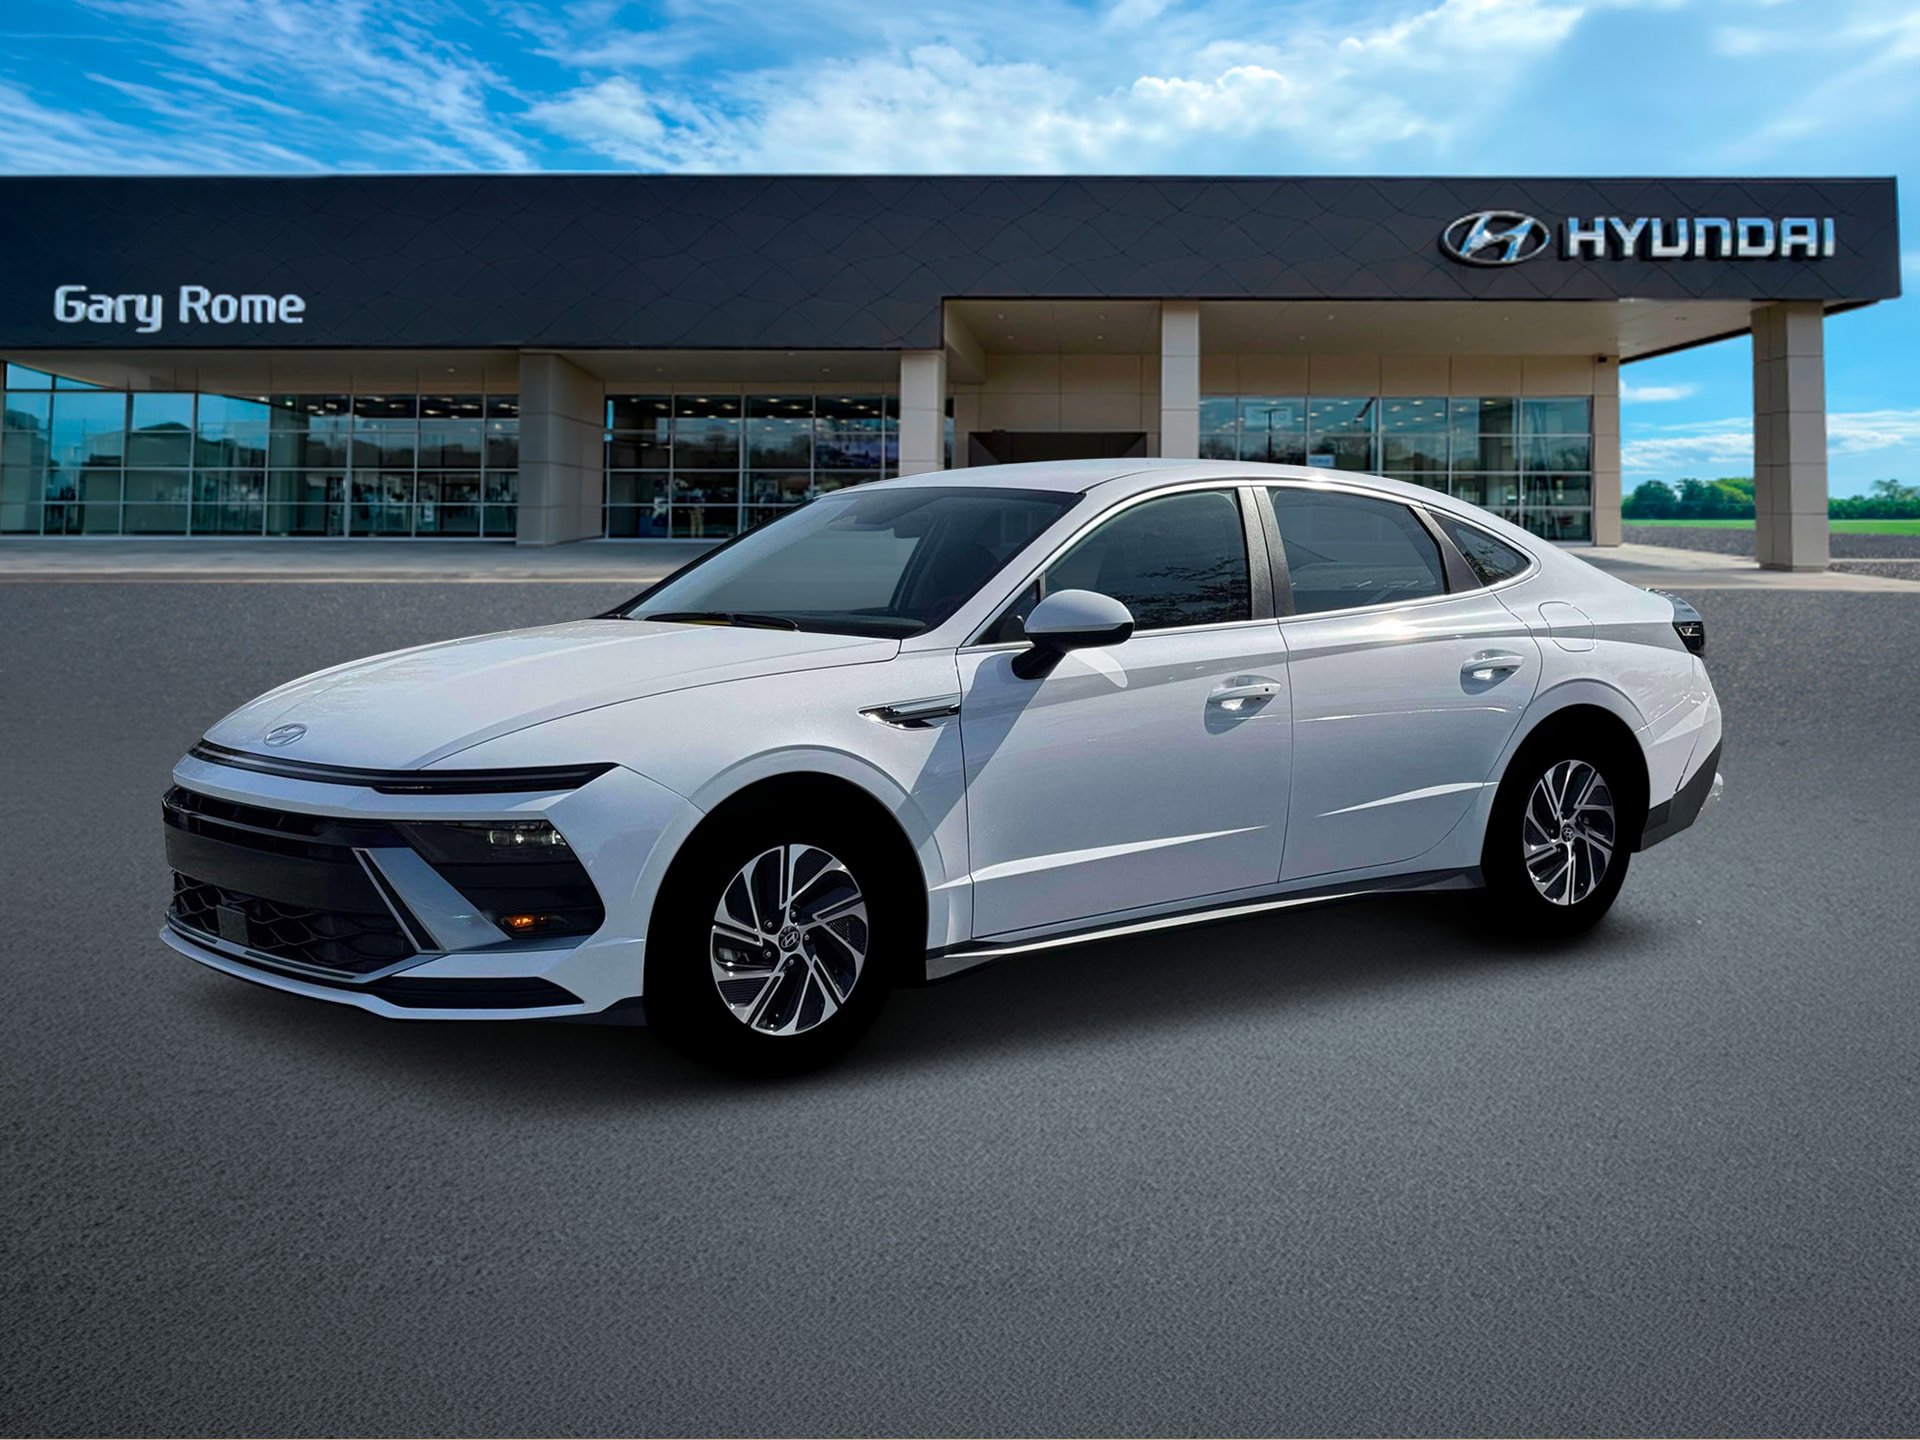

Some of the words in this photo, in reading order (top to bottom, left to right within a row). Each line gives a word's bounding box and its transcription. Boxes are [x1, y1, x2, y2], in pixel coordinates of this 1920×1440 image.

[1567, 216, 1836, 258] HYUNDAI
[53, 284, 164, 334] Gary
[178, 284, 306, 324] Rome
